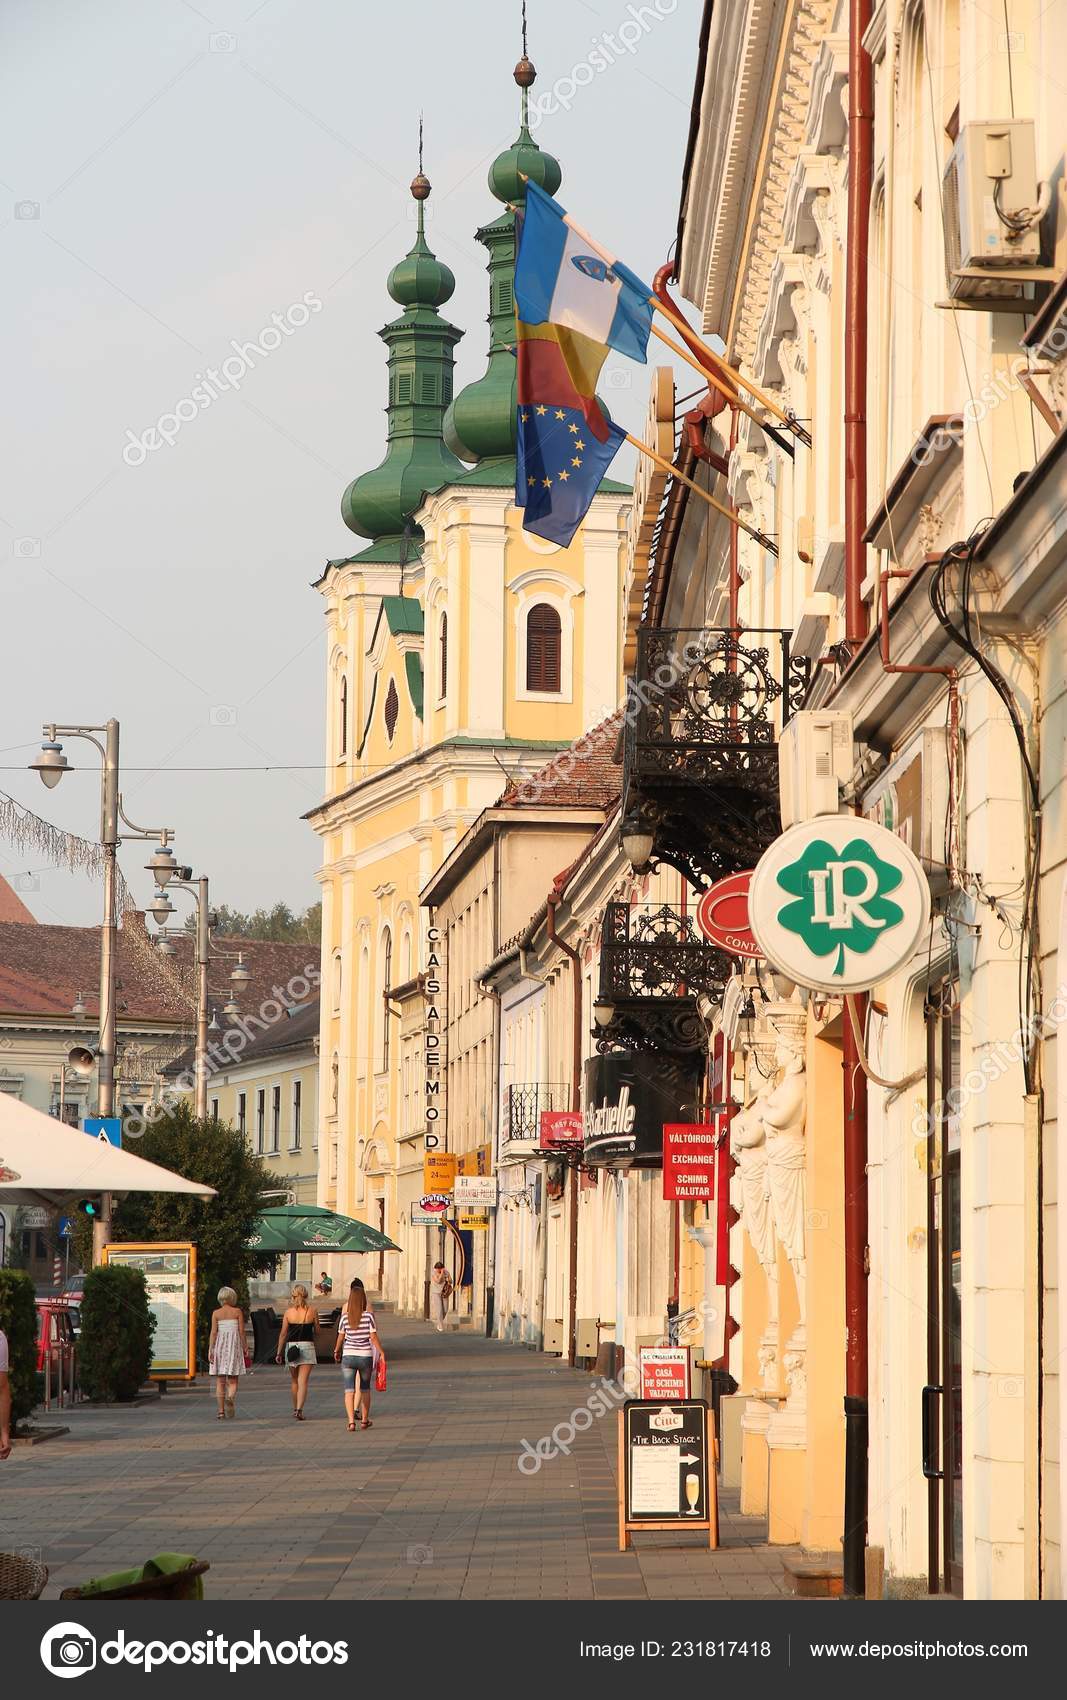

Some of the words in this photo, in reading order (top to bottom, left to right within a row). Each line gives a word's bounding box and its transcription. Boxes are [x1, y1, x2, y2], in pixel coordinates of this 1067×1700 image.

[672, 1154, 714, 1164] EXCHANGE
[677, 1174, 708, 1184] SCHIMB
[675, 1186, 710, 1195] VALUTAR
[644, 1379, 654, 1387] DE
[656, 1379, 684, 1387] SCHIMB
[649, 1389, 680, 1398] VALUTAR
[654, 1416, 678, 1427] Ciuc
